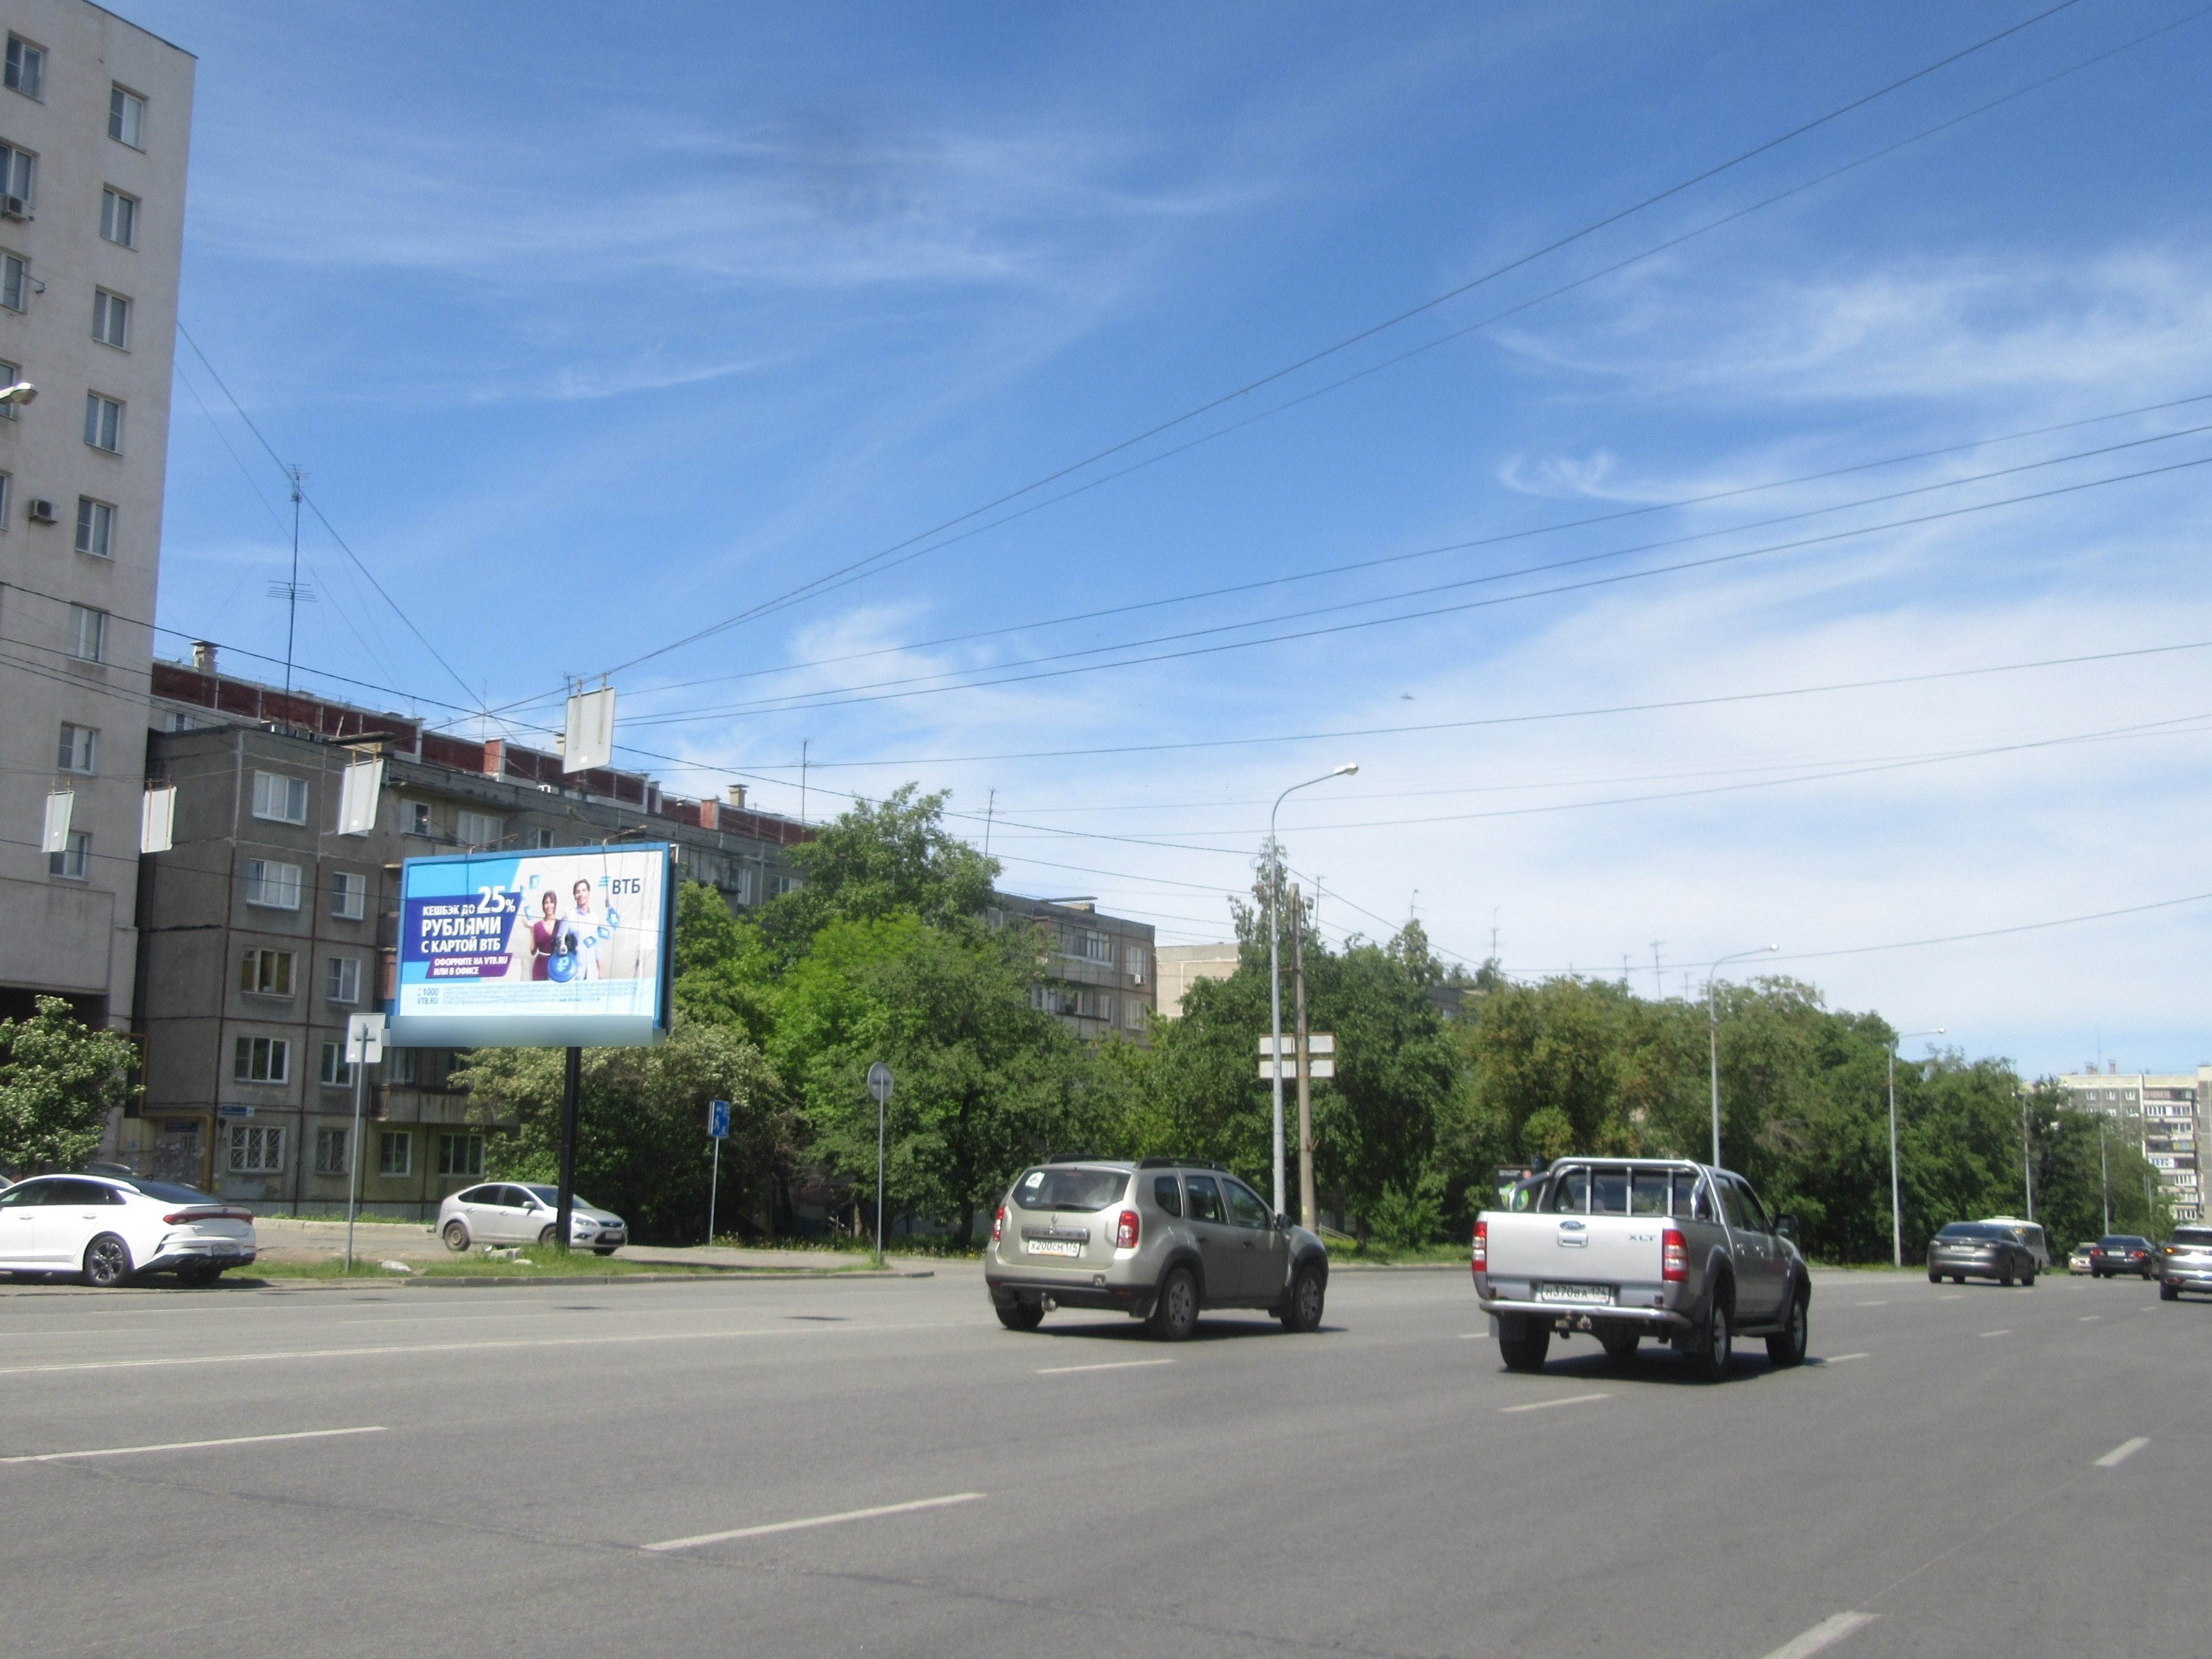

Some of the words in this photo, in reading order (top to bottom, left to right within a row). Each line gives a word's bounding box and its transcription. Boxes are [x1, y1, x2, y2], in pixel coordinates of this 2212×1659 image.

[612, 878, 641, 895] ВТБ
[422, 904, 461, 916] КЕШБЭК
[461, 904, 476, 917] ДО
[477, 885, 516, 914] 25%
[422, 916, 502, 937] РУБЛЯМИ
[421, 940, 430, 953] С
[431, 936, 478, 953] КАРТОЙ
[479, 937, 501, 952] ВТБ
[434, 957, 473, 967] ОФОРМИТЕ
[474, 956, 483, 965] НА
[484, 955, 509, 965] VTB.RU
[433, 967, 449, 976] ИЛИ
[449, 967, 455, 976] В
[455, 966, 480, 975] ОФИСЕ
[423, 987, 440, 996] 1000
[1628, 1233, 1657, 1242] XLT
